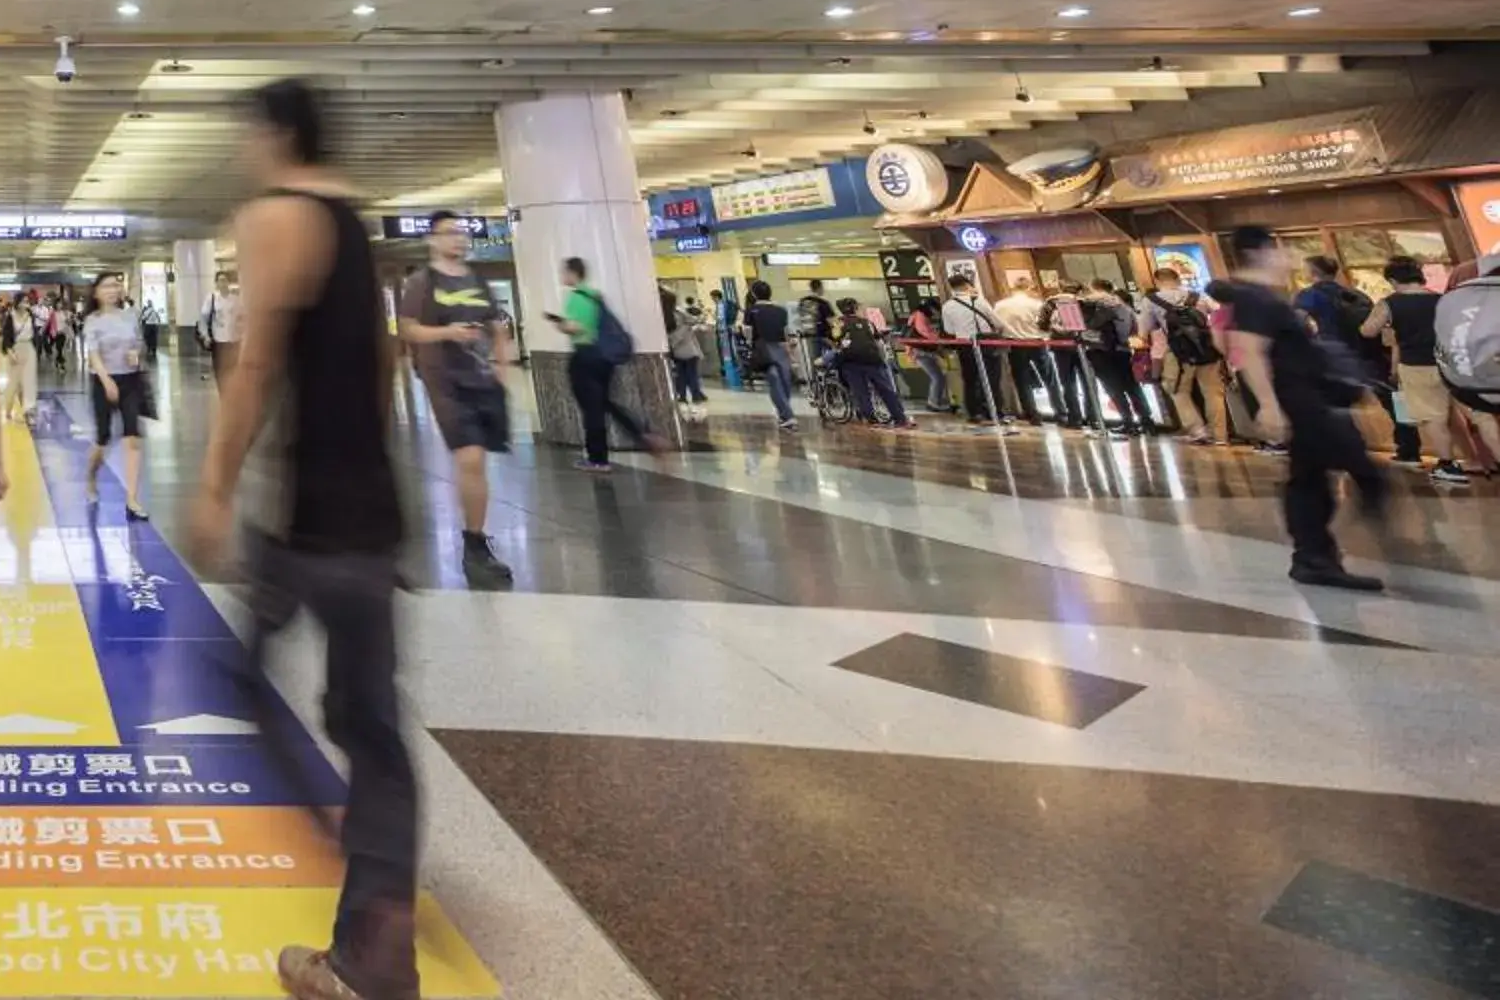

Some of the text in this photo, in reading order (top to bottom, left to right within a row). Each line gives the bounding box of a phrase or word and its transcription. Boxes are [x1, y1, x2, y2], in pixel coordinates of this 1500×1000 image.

[884, 256, 900, 277] 2
[78, 778, 252, 794] Entrance
[95, 849, 296, 870] Entrance
[77, 947, 178, 979] City
[192, 946, 280, 975] Hal
